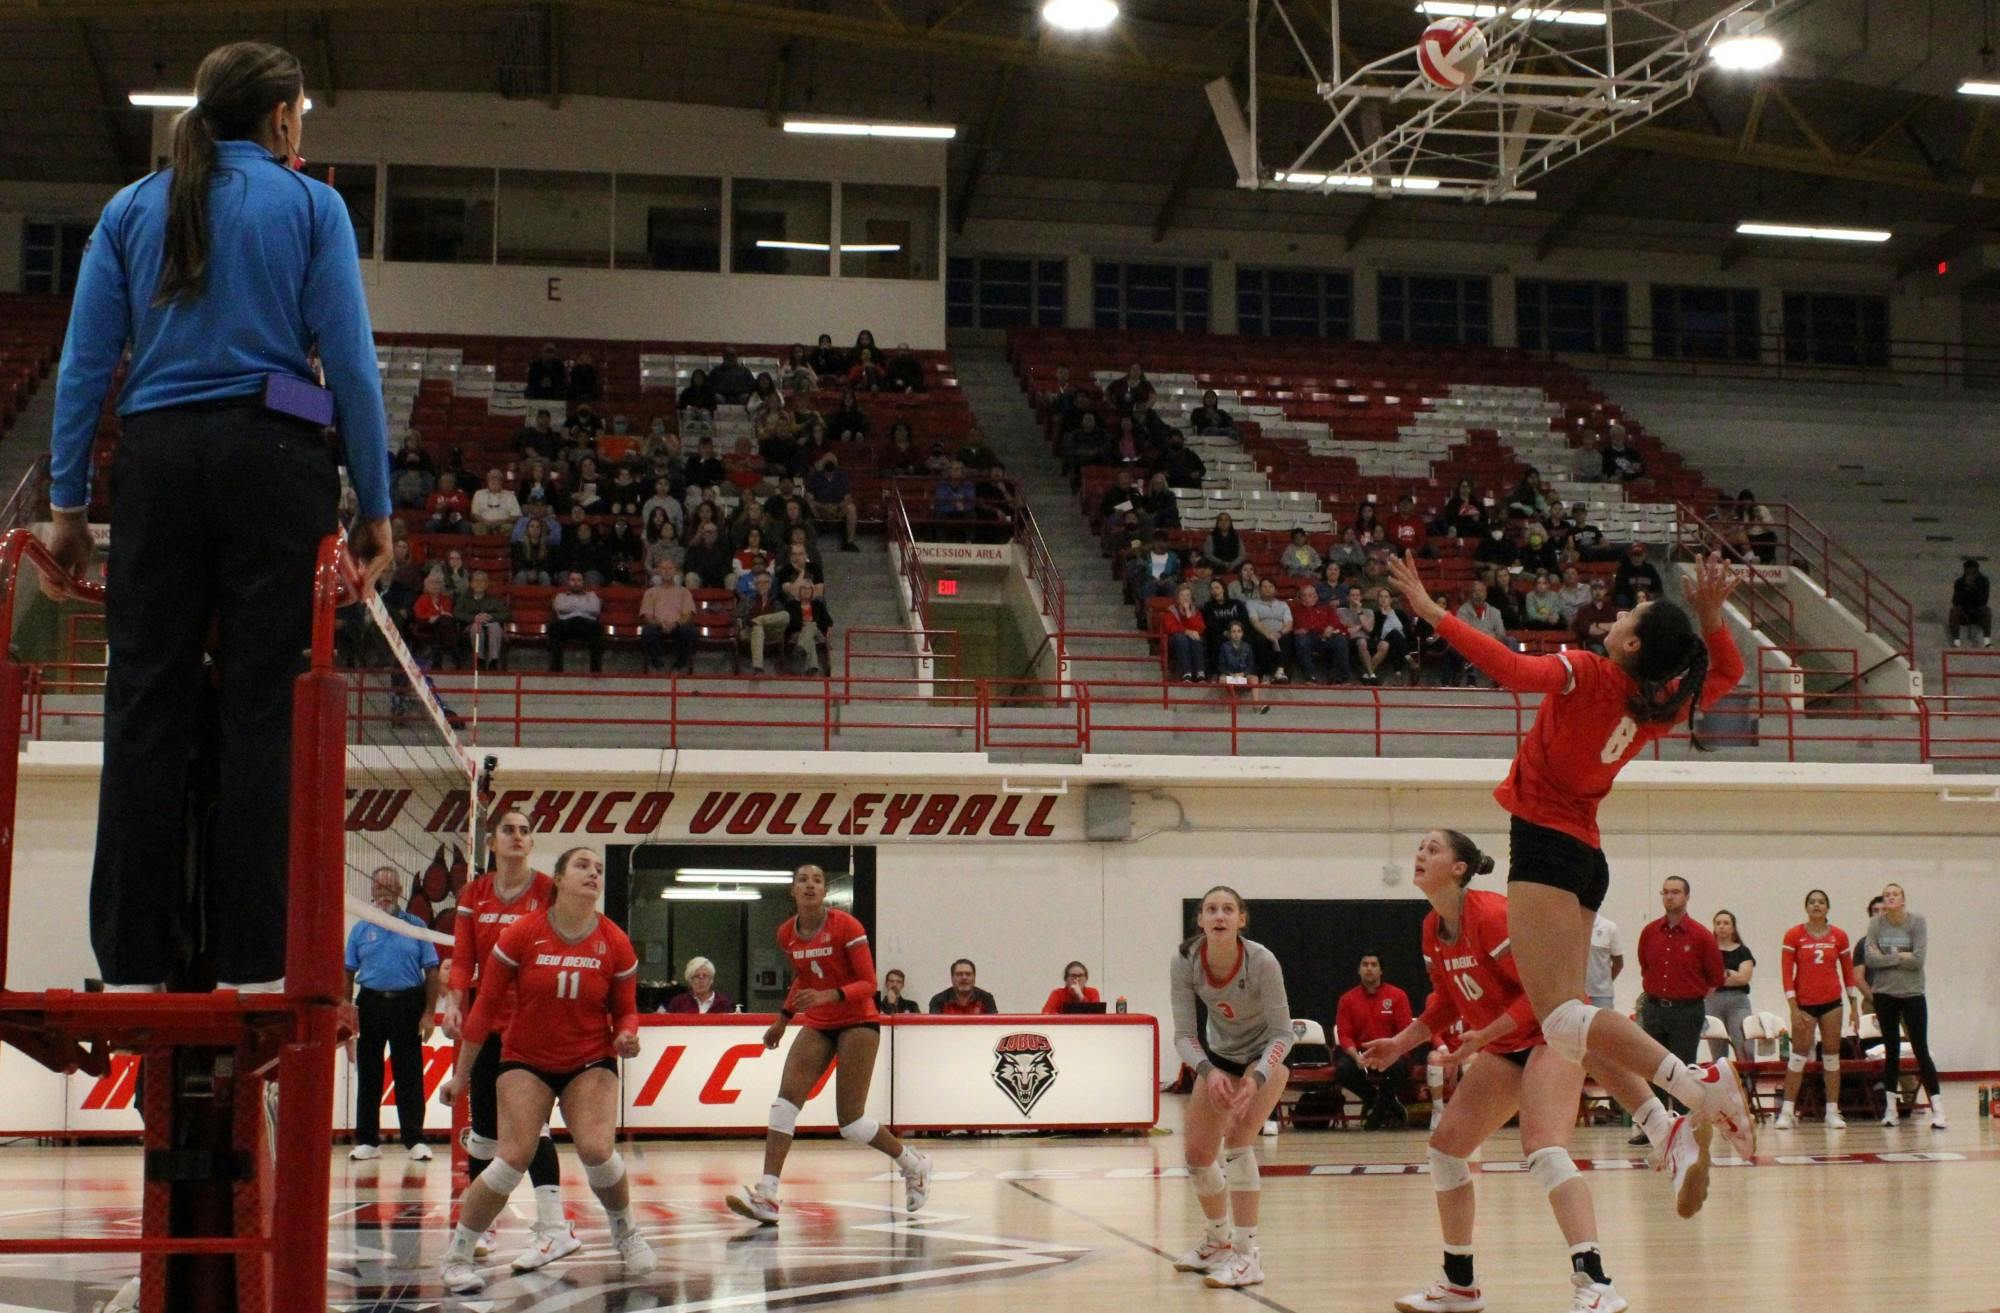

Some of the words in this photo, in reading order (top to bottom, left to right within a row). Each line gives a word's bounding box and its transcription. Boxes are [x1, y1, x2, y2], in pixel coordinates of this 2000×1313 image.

[548, 277, 561, 301] E
[976, 549, 1002, 560] AREA
[922, 658, 929, 669] E
[1793, 673, 1801, 685] D
[1912, 676, 1919, 687] C
[1600, 715, 1638, 765] 8
[424, 789, 676, 834] MEXICO
[688, 791, 1059, 837] VOLLEYBALL
[536, 953, 562, 966] NEW
[561, 955, 602, 969] MEXICO
[1814, 949, 1825, 964] 2
[556, 970, 580, 1000] 11
[1453, 972, 1484, 1001] 10
[1216, 1002, 1234, 1019] 3
[995, 1032, 1054, 1052] LOBOS
